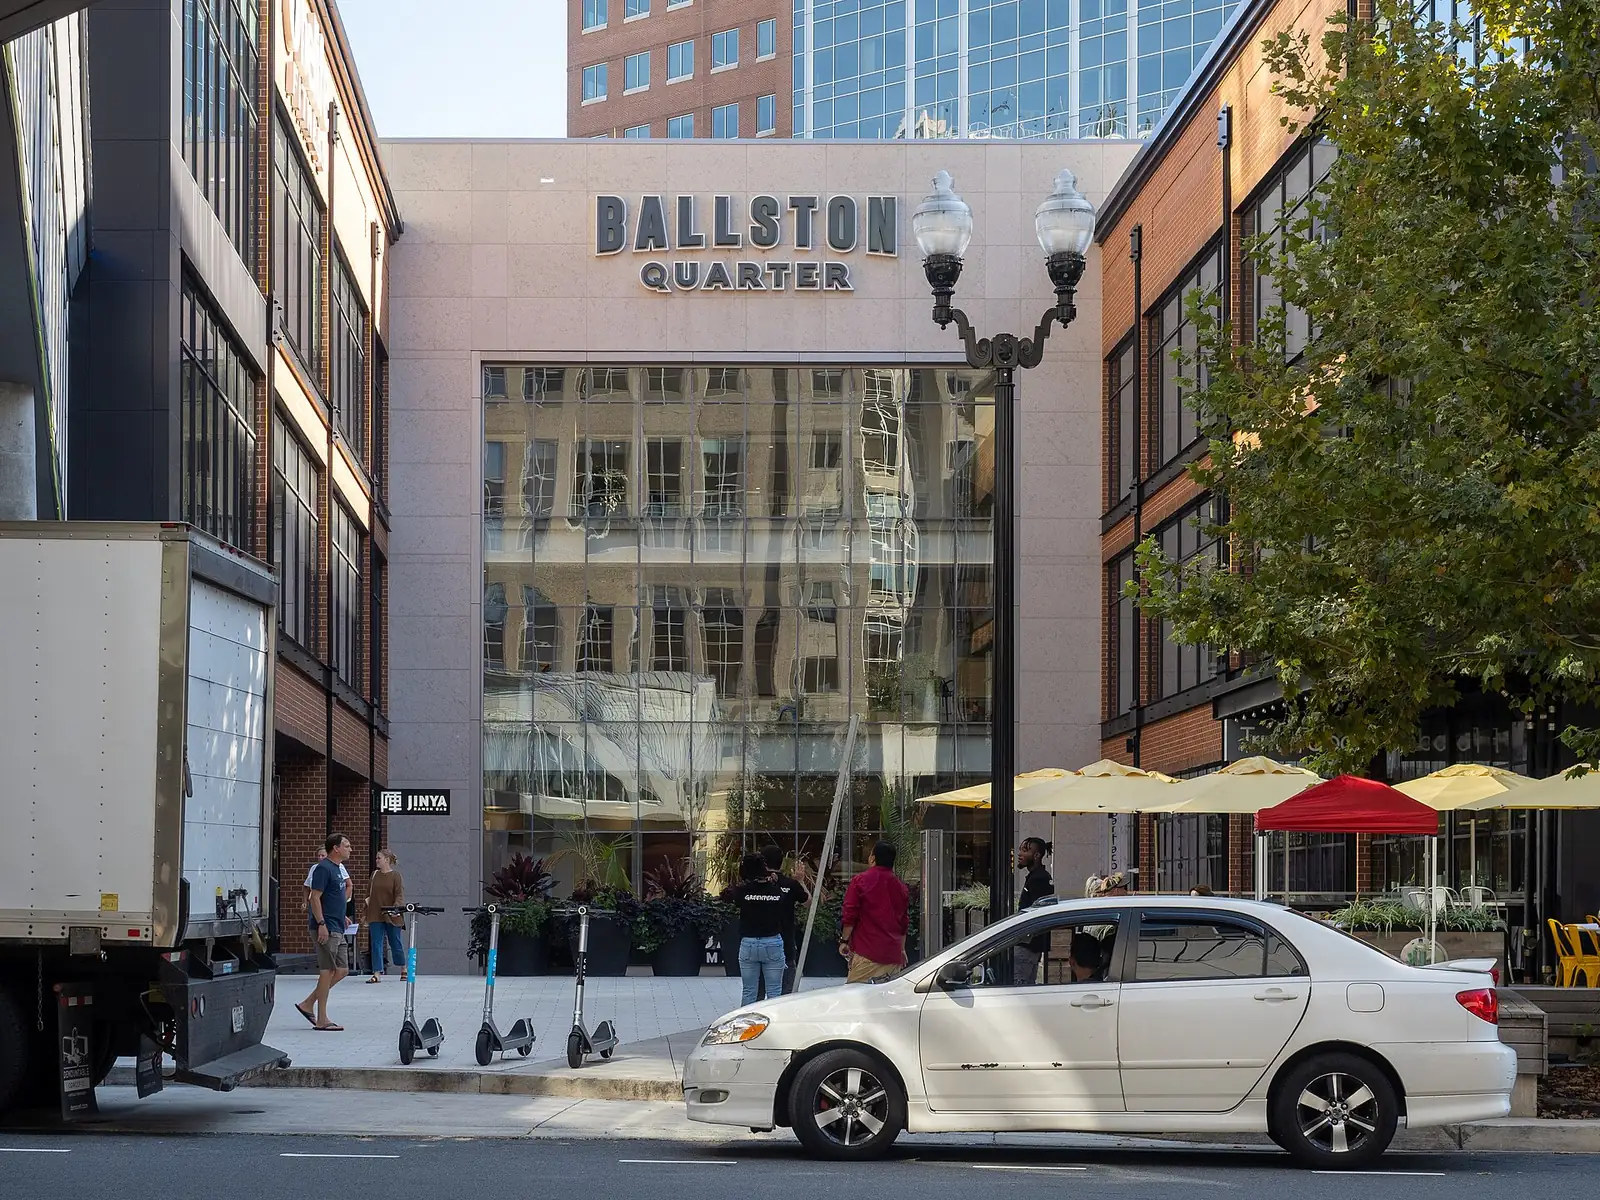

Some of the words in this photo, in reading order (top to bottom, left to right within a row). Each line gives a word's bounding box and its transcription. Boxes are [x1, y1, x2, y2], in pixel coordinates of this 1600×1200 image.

[596, 194, 898, 257] BALLSTON
[639, 261, 854, 293] QUARTER
[407, 795, 447, 811] JINYA
